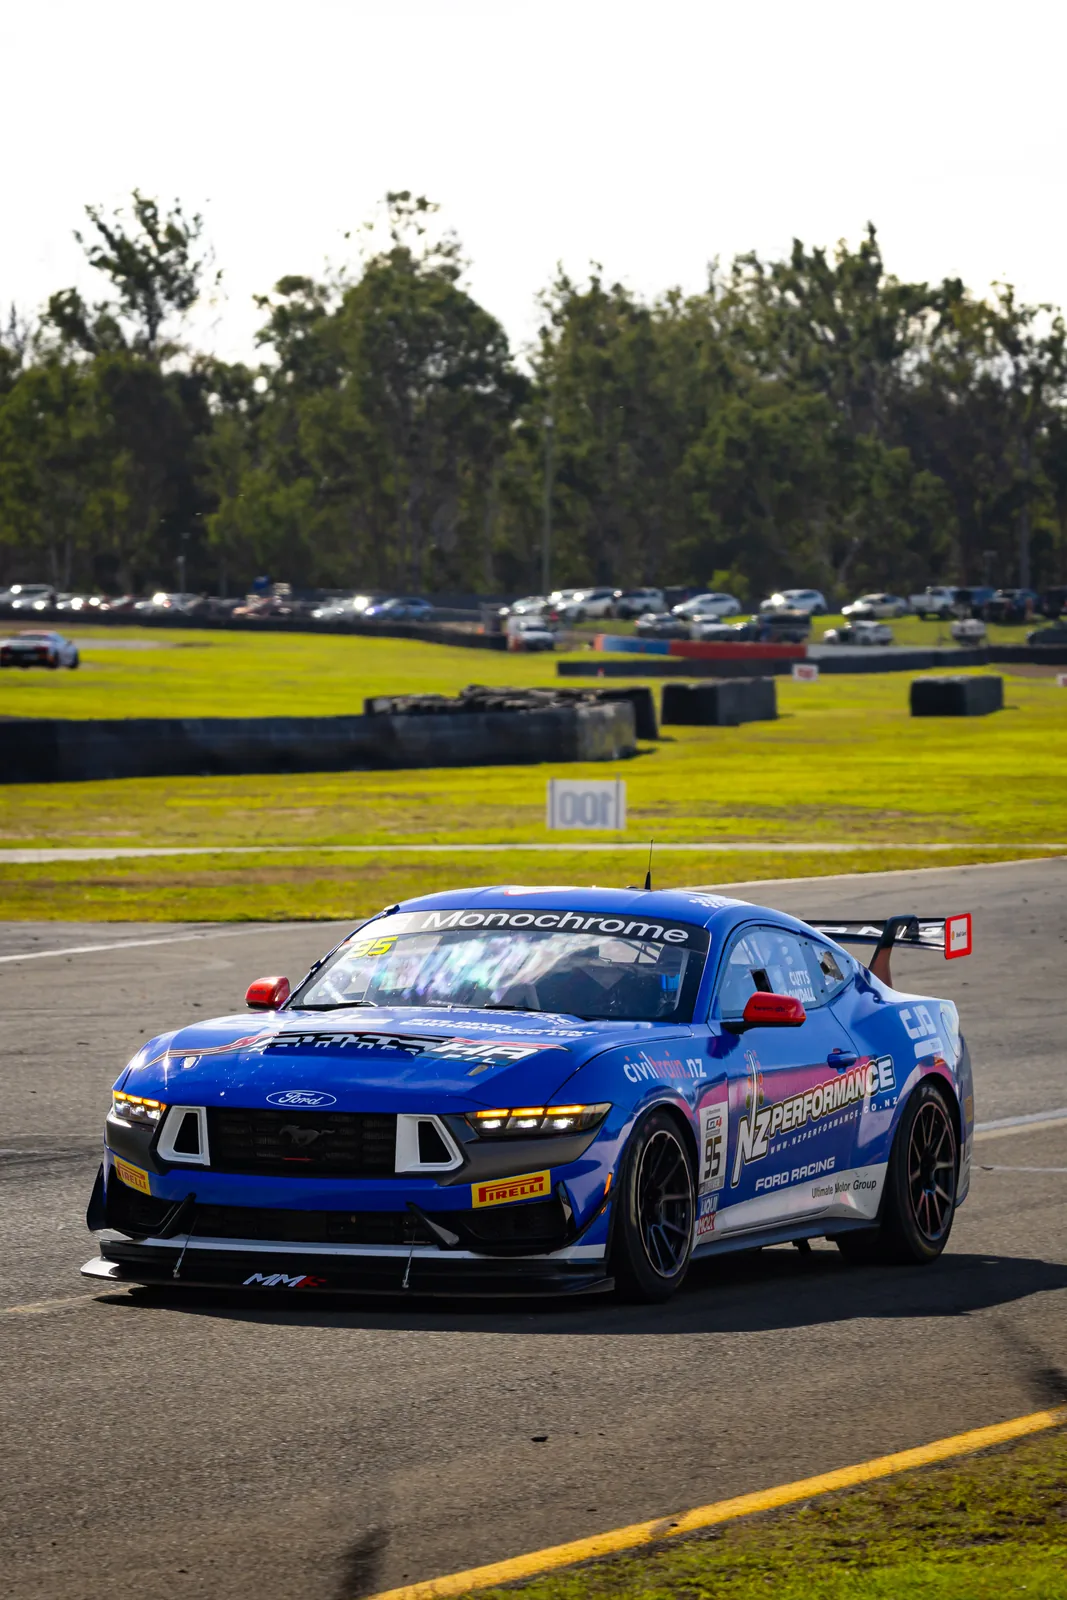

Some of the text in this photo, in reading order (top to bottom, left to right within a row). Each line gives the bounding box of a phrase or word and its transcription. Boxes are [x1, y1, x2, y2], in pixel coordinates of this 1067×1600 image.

[420, 910, 690, 944] Monochrome
[350, 936, 398, 959] 95
[623, 1051, 708, 1083] civiltrain.nz
[279, 1091, 325, 1106] Ford
[704, 1136, 722, 1180] 95
[117, 1161, 147, 1190] PIRELLI
[755, 1156, 836, 1191] FORD RACING
[478, 1176, 545, 1203] PIRELLI
[811, 1185, 833, 1199] Ultimate
[852, 1179, 877, 1191] Group
